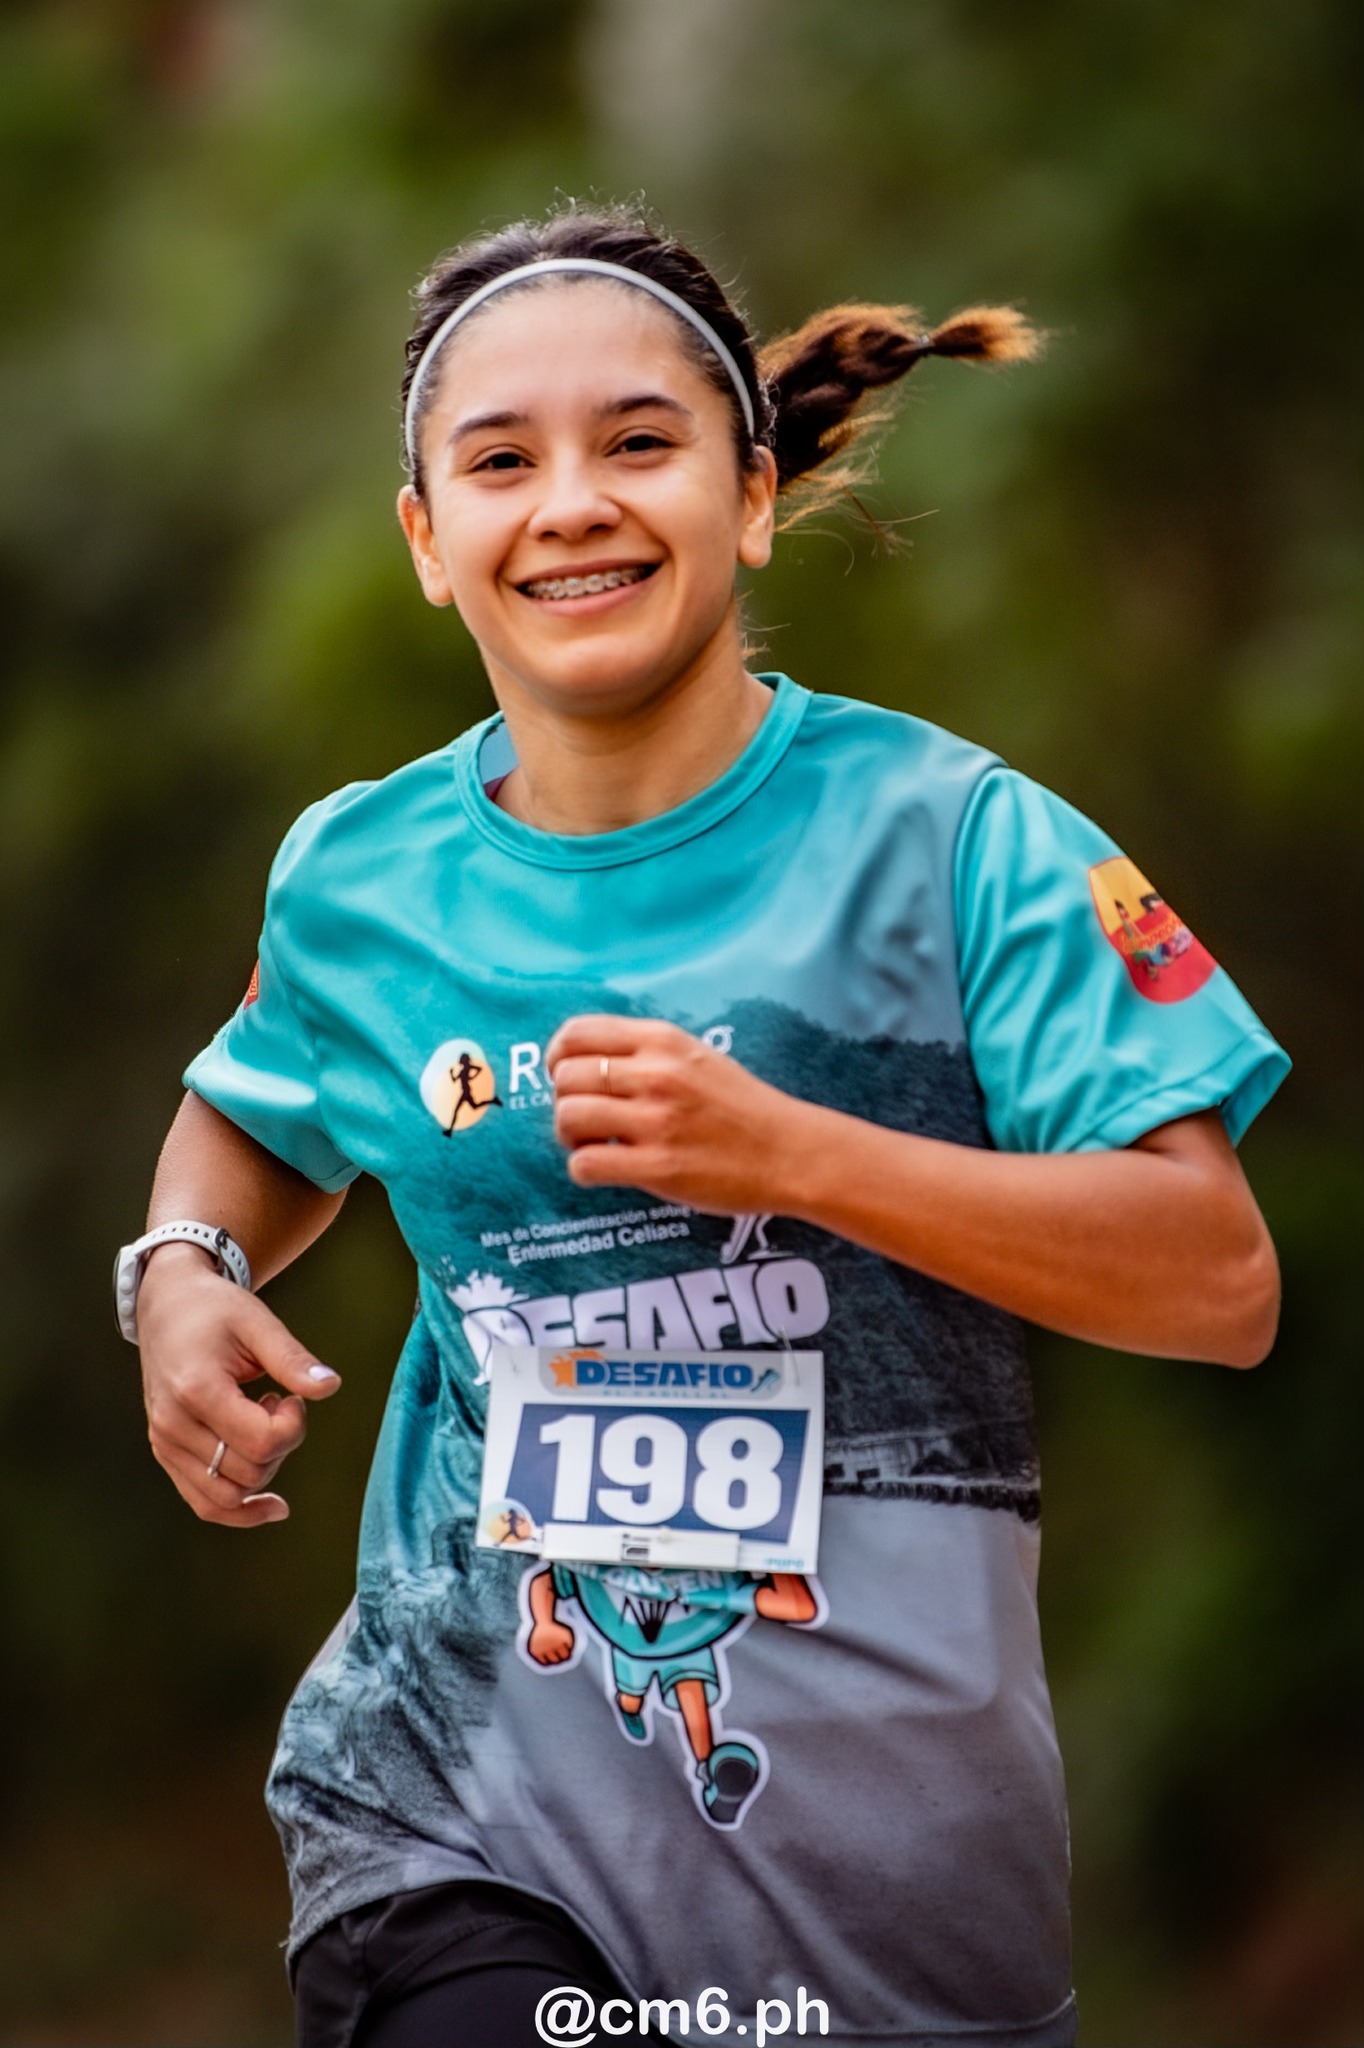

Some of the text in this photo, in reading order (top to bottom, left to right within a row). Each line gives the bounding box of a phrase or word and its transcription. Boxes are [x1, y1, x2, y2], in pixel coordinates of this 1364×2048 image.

[480, 1231, 511, 1248] Mes
[512, 1228, 530, 1242] de
[507, 1231, 614, 1266] Enfermedad
[575, 1359, 753, 1389] DESAFIO
[539, 1413, 784, 1530] 198
